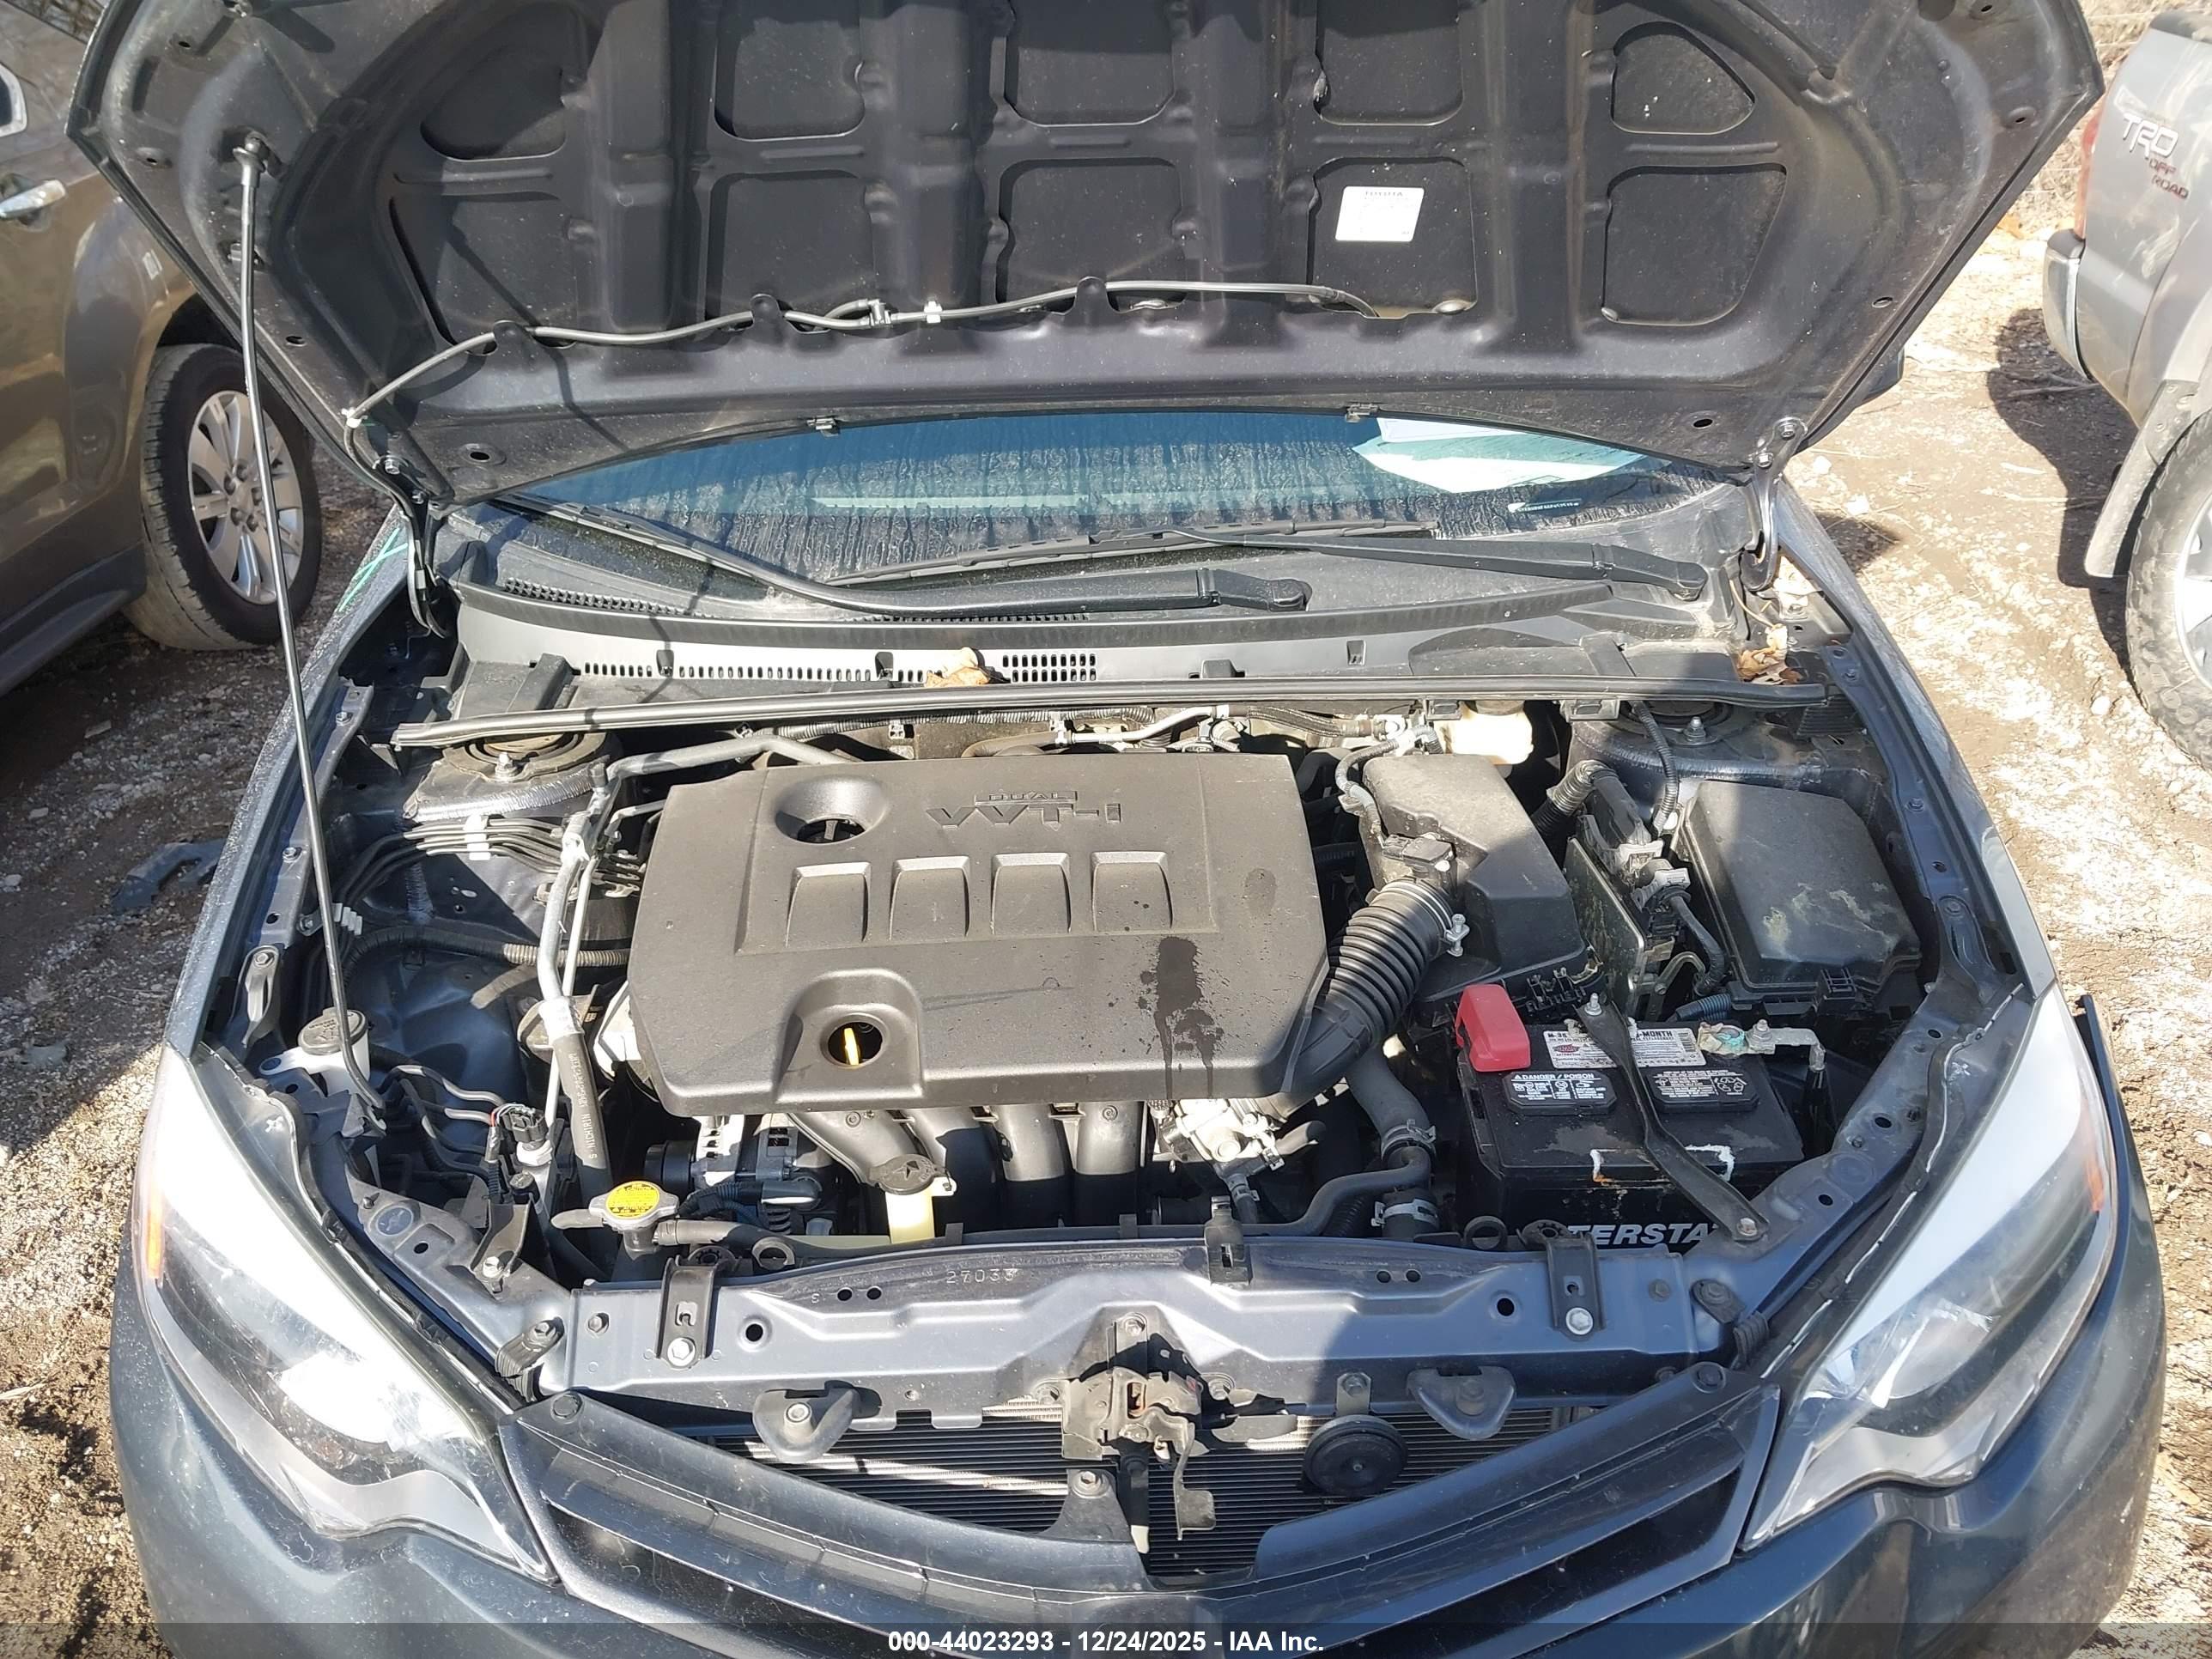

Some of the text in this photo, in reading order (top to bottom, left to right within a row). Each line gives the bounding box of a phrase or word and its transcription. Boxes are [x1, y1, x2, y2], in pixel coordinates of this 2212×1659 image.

[2123, 112, 2179, 160] TRD
[2148, 158, 2177, 174] OFF
[2152, 174, 2190, 199] ROAD
[988, 792, 1069, 801] DUAL
